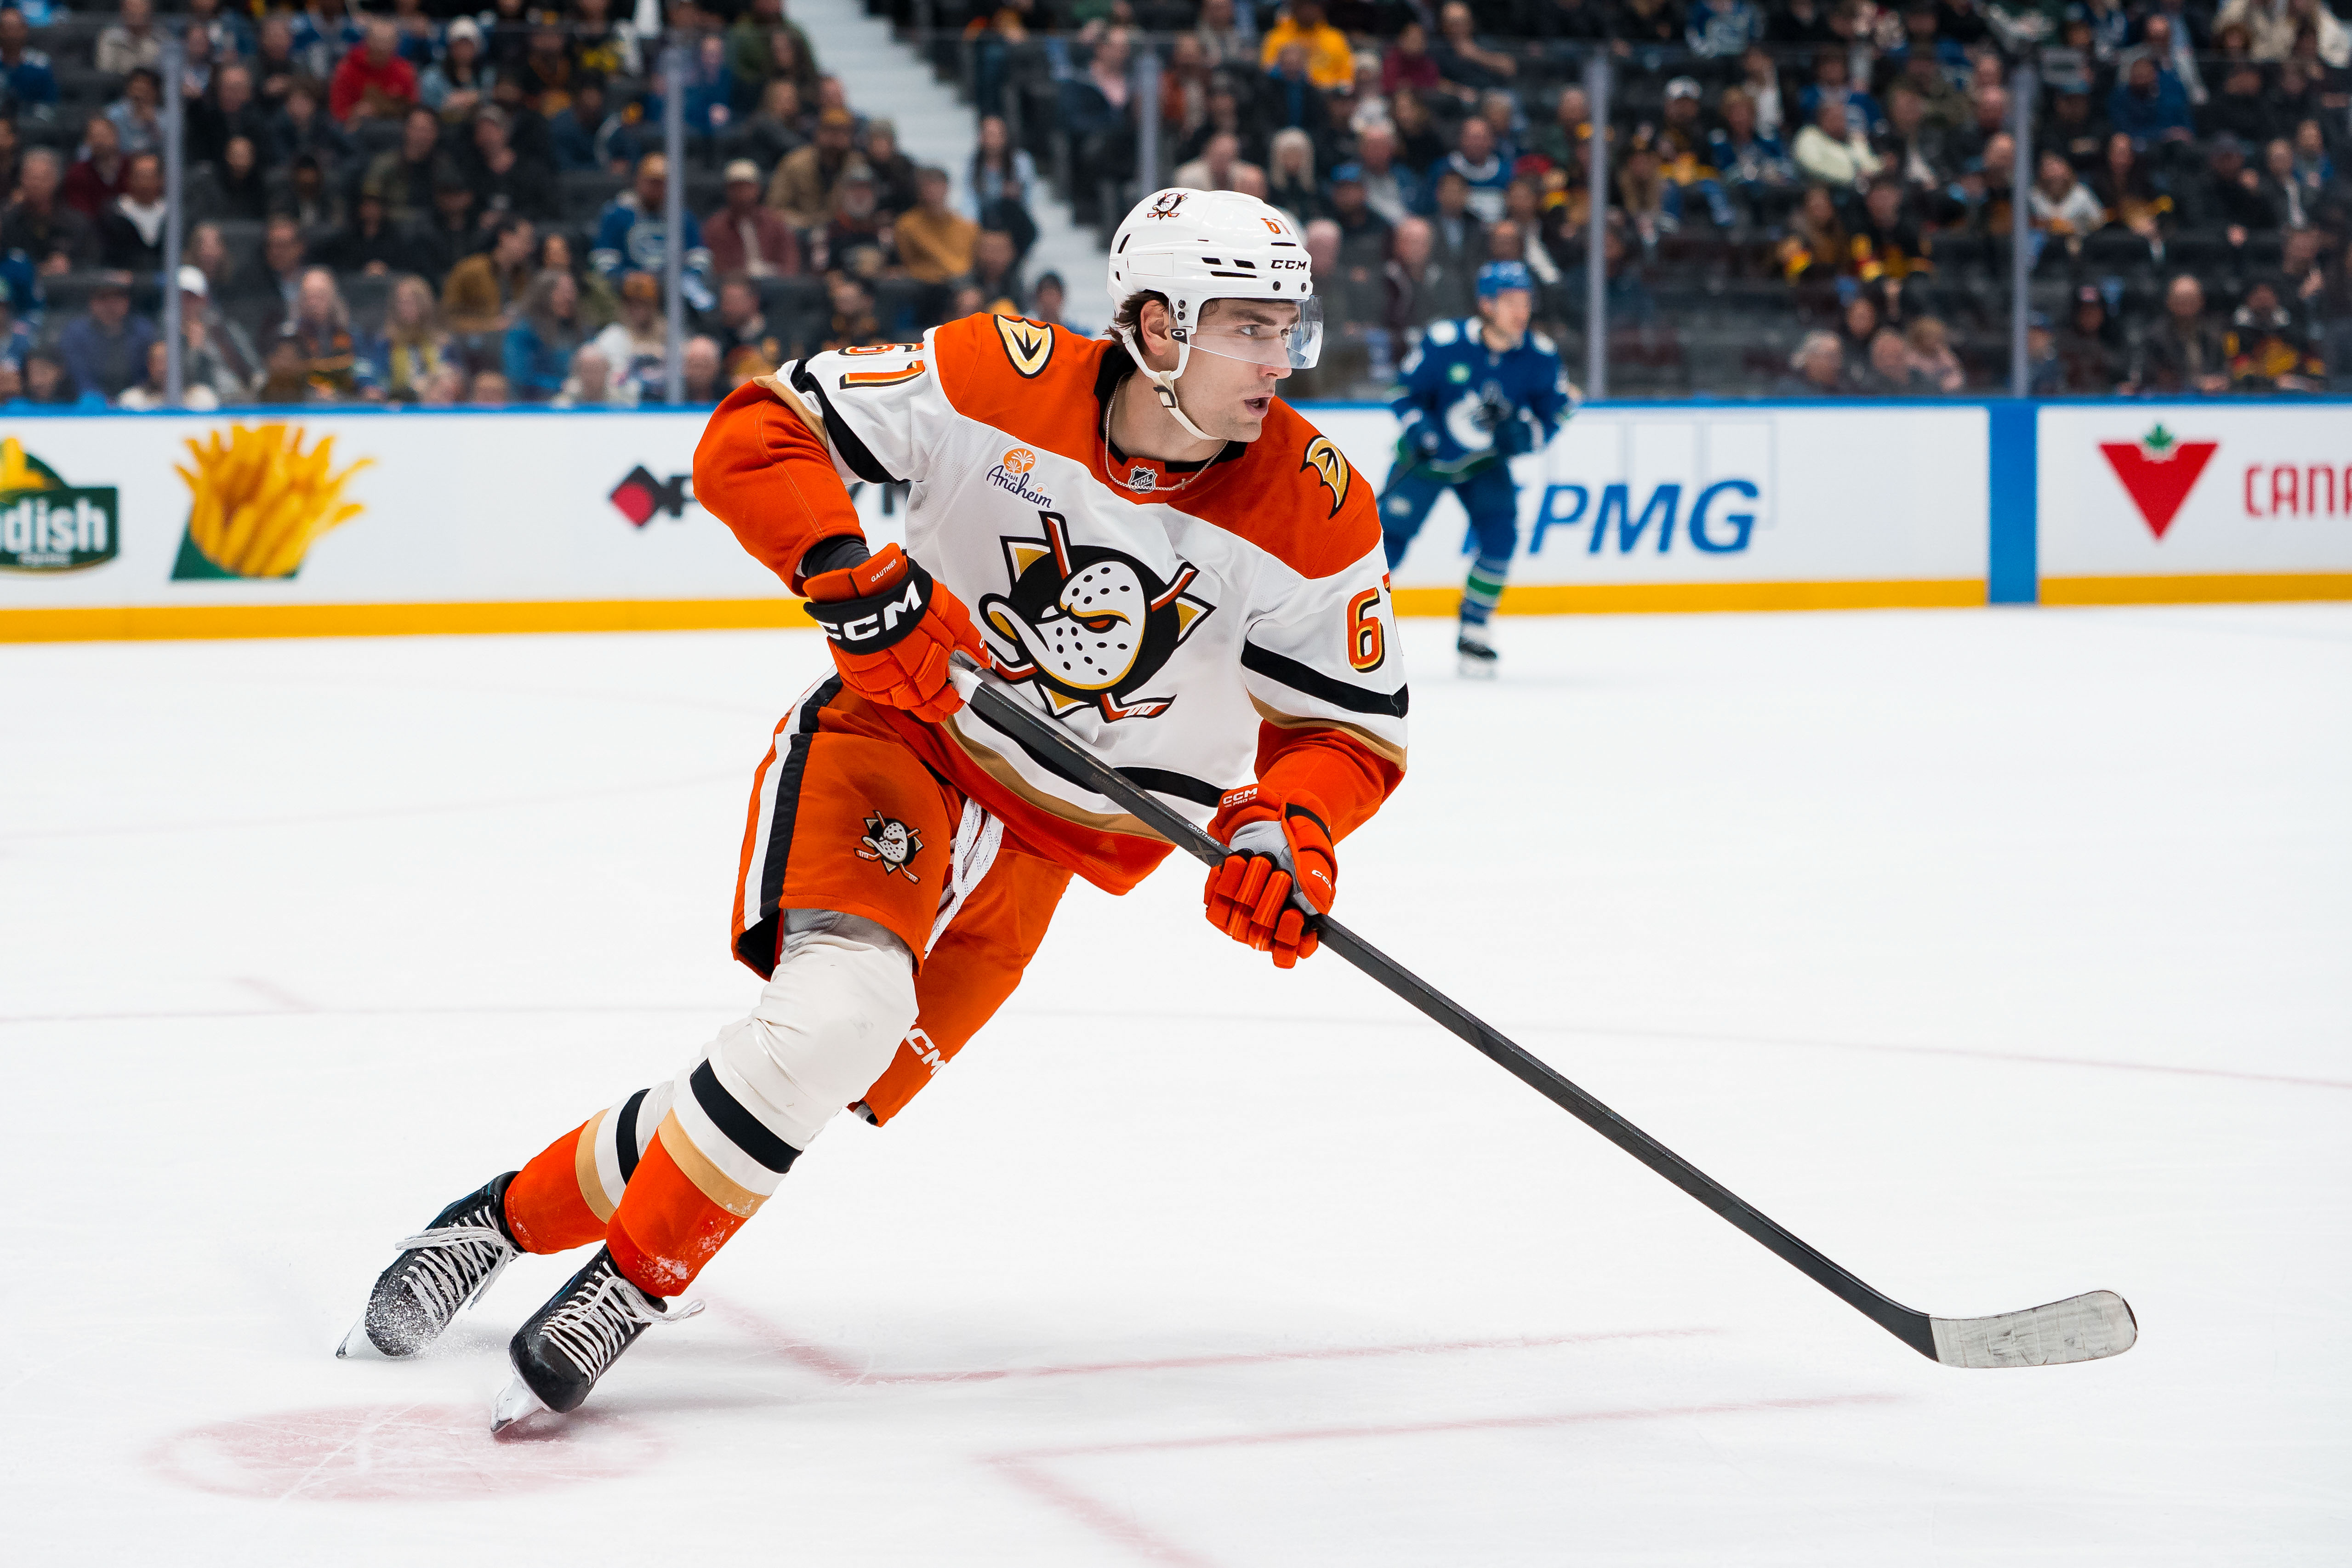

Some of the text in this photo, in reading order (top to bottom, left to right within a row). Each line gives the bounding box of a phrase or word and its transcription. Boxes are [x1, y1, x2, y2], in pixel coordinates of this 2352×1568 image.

[1270, 260, 1307, 270] CCM
[986, 465, 1052, 508] Anaheim
[1005, 472, 1018, 482] visit
[1134, 476, 1151, 486] NHL
[1462, 479, 1759, 554] PMG
[871, 559, 897, 582] GAUTHIER
[1223, 787, 1258, 804] CCM
[1188, 823, 1221, 846] GAUTHIER
[1312, 870, 1332, 891] CC
[905, 1021, 946, 1076] CM
